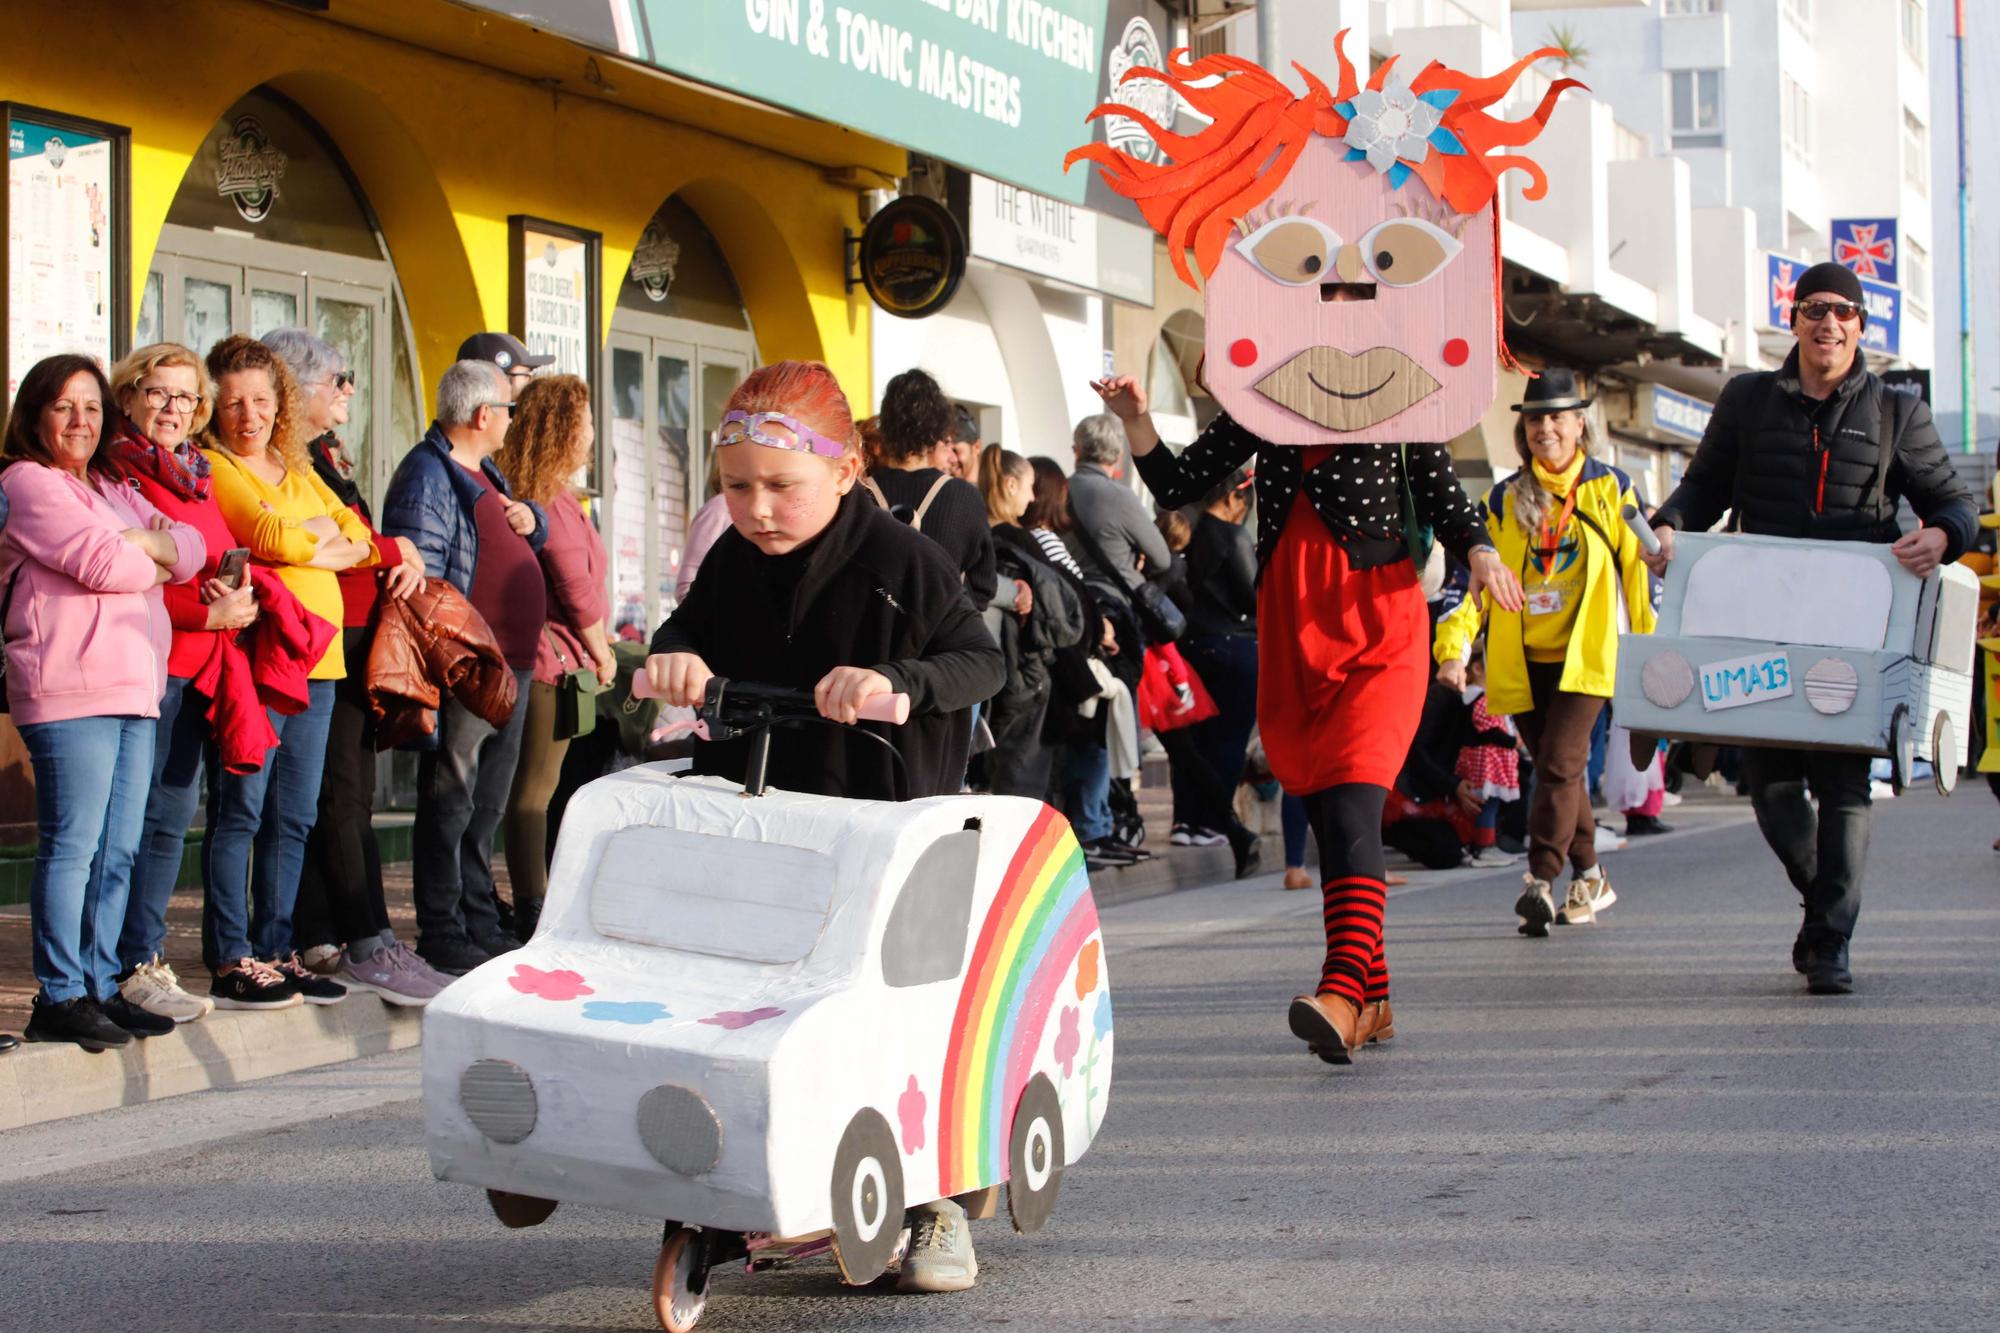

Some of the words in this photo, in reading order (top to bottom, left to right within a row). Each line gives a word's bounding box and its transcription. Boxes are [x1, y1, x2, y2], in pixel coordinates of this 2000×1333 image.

[1006, 0, 1094, 74] KITCHEN
[745, 0, 799, 46] GIN
[806, 0, 829, 58] &
[836, 6, 912, 88] TONIC
[918, 39, 1021, 128] MASTERS
[1863, 290, 1894, 321] LINIC
[528, 330, 581, 376] OCKTAILS
[1704, 658, 1789, 702] UMA13
